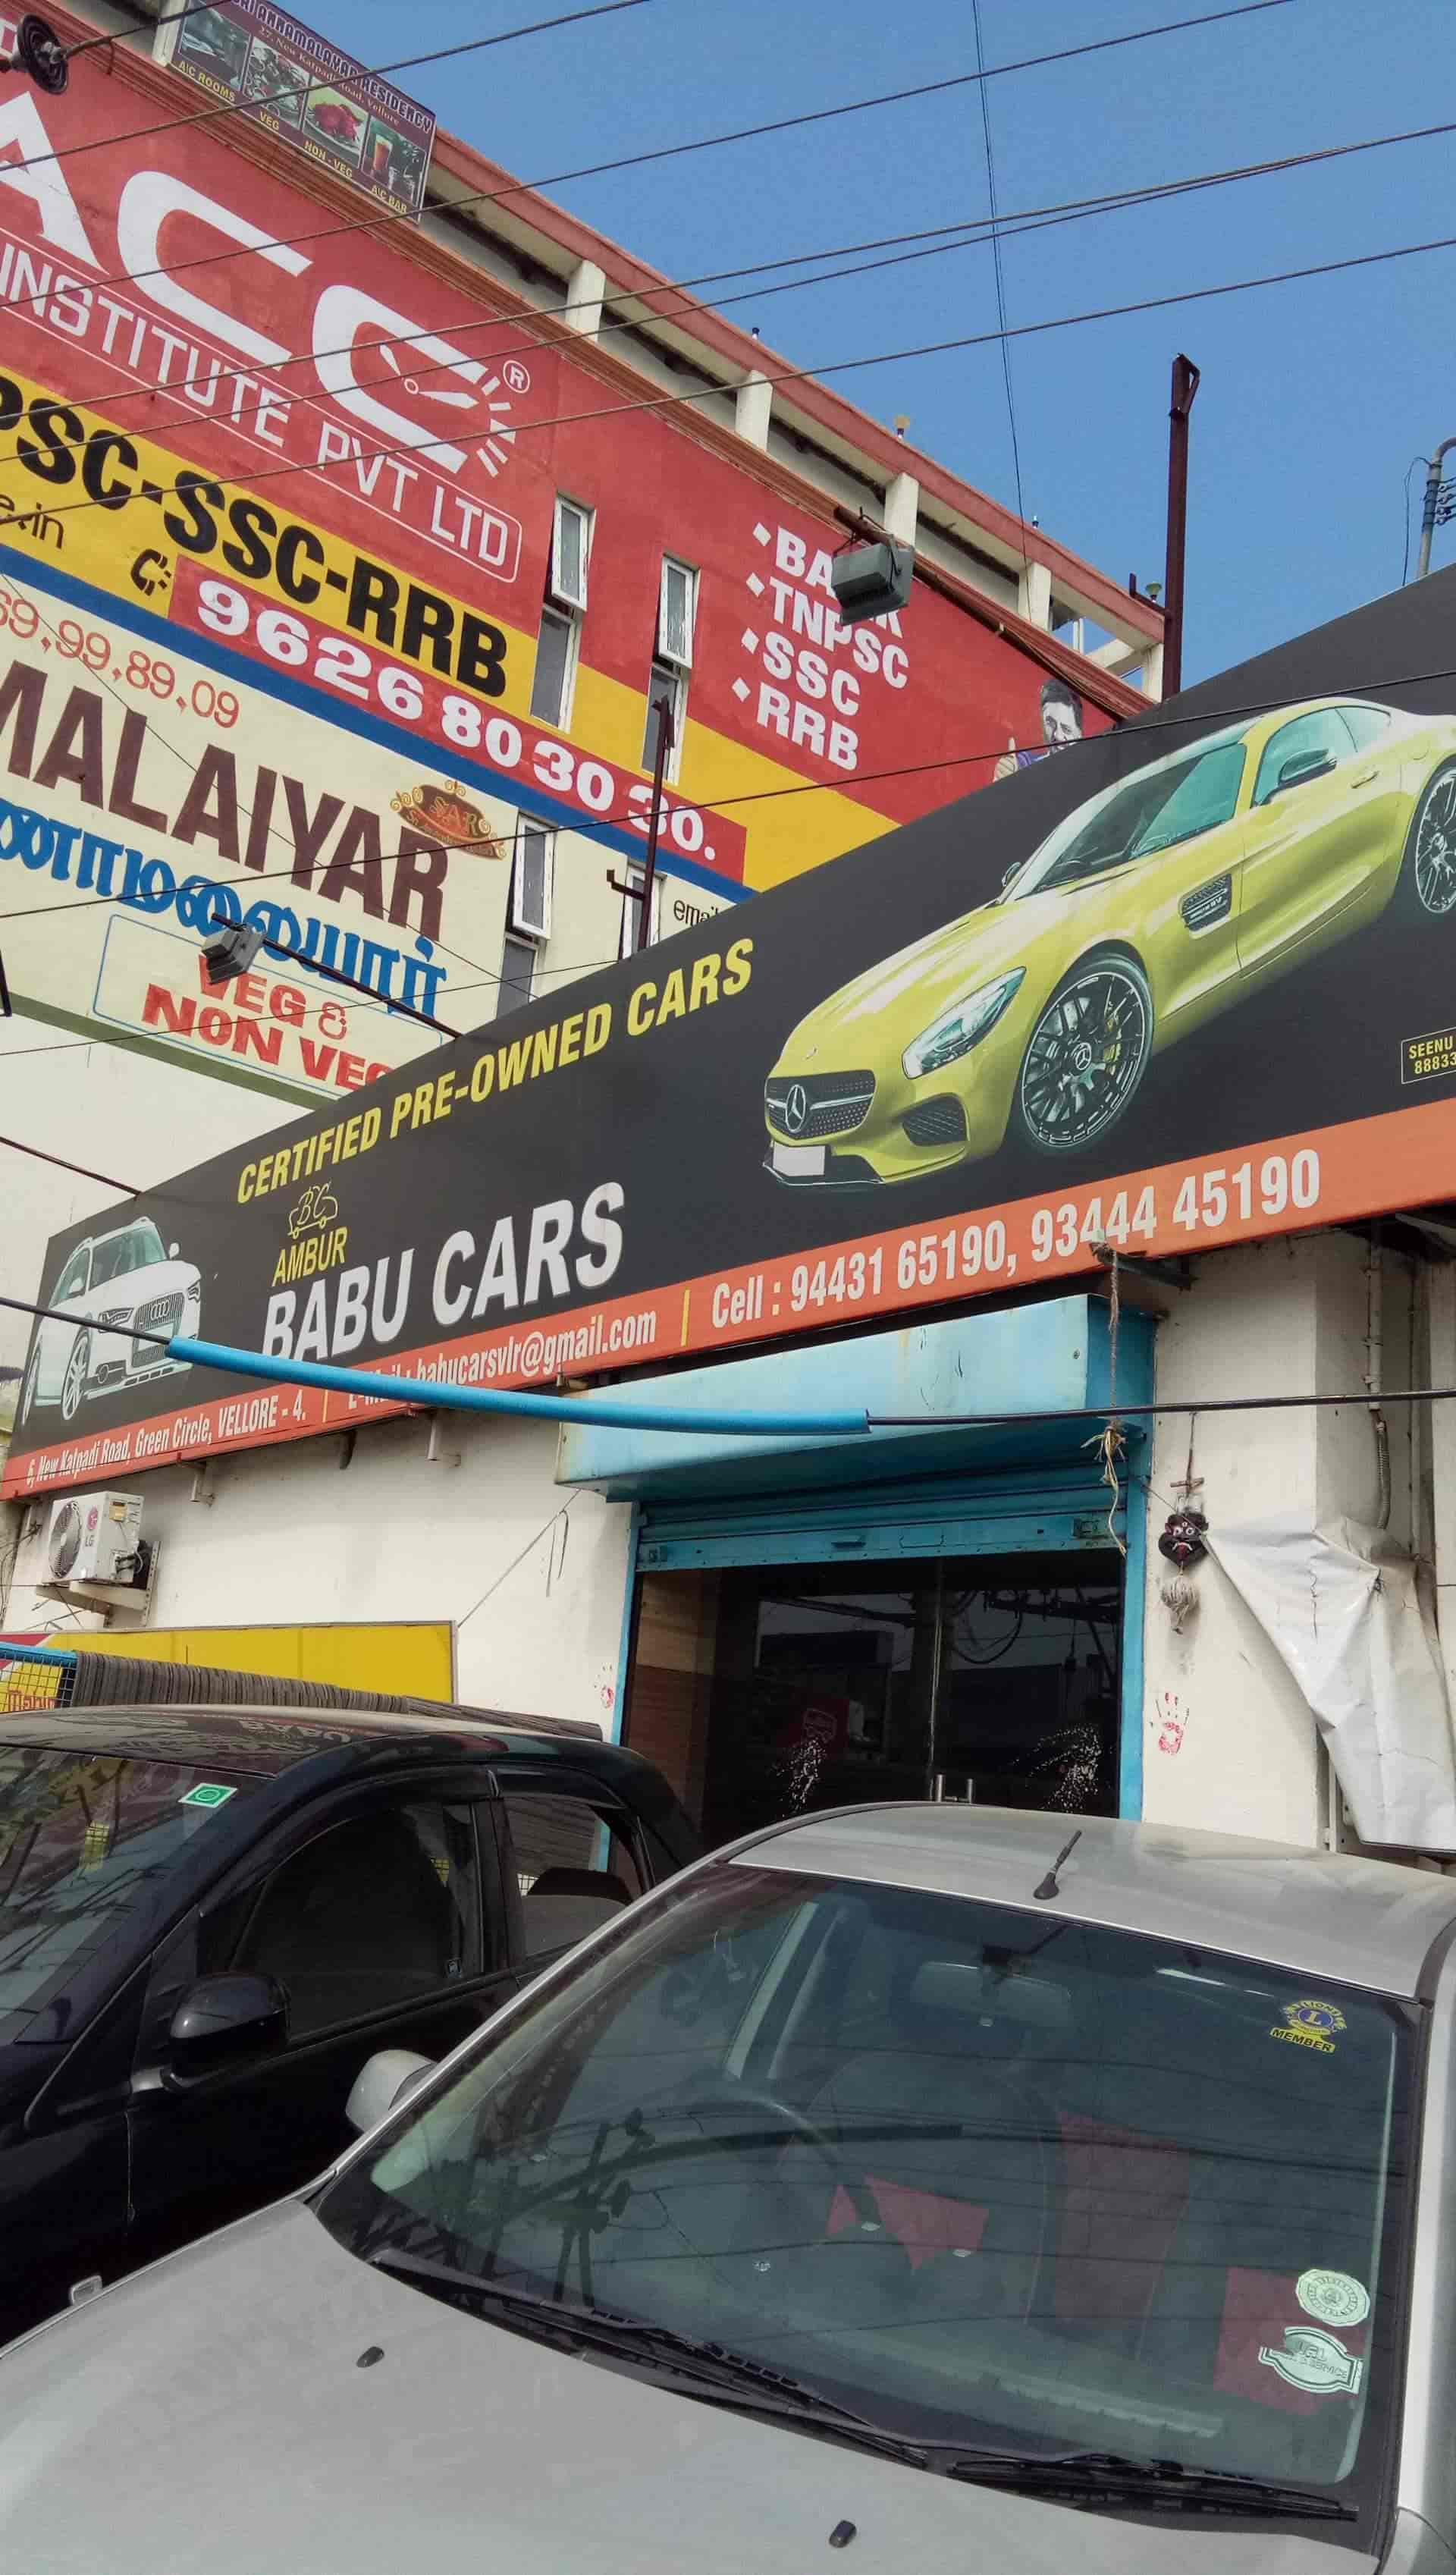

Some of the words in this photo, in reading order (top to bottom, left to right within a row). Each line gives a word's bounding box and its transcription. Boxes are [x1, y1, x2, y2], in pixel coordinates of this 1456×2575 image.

[197, 72, 237, 102] ROOMS
[260, 111, 280, 131] VEG
[360, 75, 433, 134] RESIDENCY
[303, 140, 327, 162] NON
[333, 158, 353, 177] VEG
[388, 195, 408, 215] BAR
[0, 242, 291, 448] INSTITUTE
[317, 421, 419, 512] PVT
[431, 485, 508, 567] LTD
[763, 631, 861, 716] SSC
[770, 576, 909, 689] TNPSC
[197, 579, 425, 721] 9626
[441, 695, 522, 768] 80
[533, 740, 616, 812] 30
[757, 682, 858, 771] RRB
[140, 984, 284, 1066] NON
[1408, 1035, 1454, 1059] SEENU
[237, 1107, 382, 1204] CERTIFIED
[390, 1003, 613, 1139] PRE-OWNED
[626, 937, 754, 1037] CARS
[262, 1248, 416, 1362] BABU
[432, 1181, 626, 1328] CARS
[271, 1226, 348, 1287] AMBUR
[712, 1275, 763, 1329] Cell
[790, 1253, 883, 1312] 94431
[896, 1220, 1018, 1289] 65190,
[1031, 1185, 1158, 1263] 93444
[1172, 1148, 1321, 1233] 45190
[37, 1455, 58, 1481] New
[102, 1433, 132, 1466] Road,
[135, 1427, 171, 1459] Green
[172, 1412, 213, 1445] Circle,
[218, 1394, 279, 1439] VELLORE
[293, 1389, 307, 1422] 4.
[84, 1534, 95, 1547] LG
[1272, 2028, 1333, 2052] MEMBER
